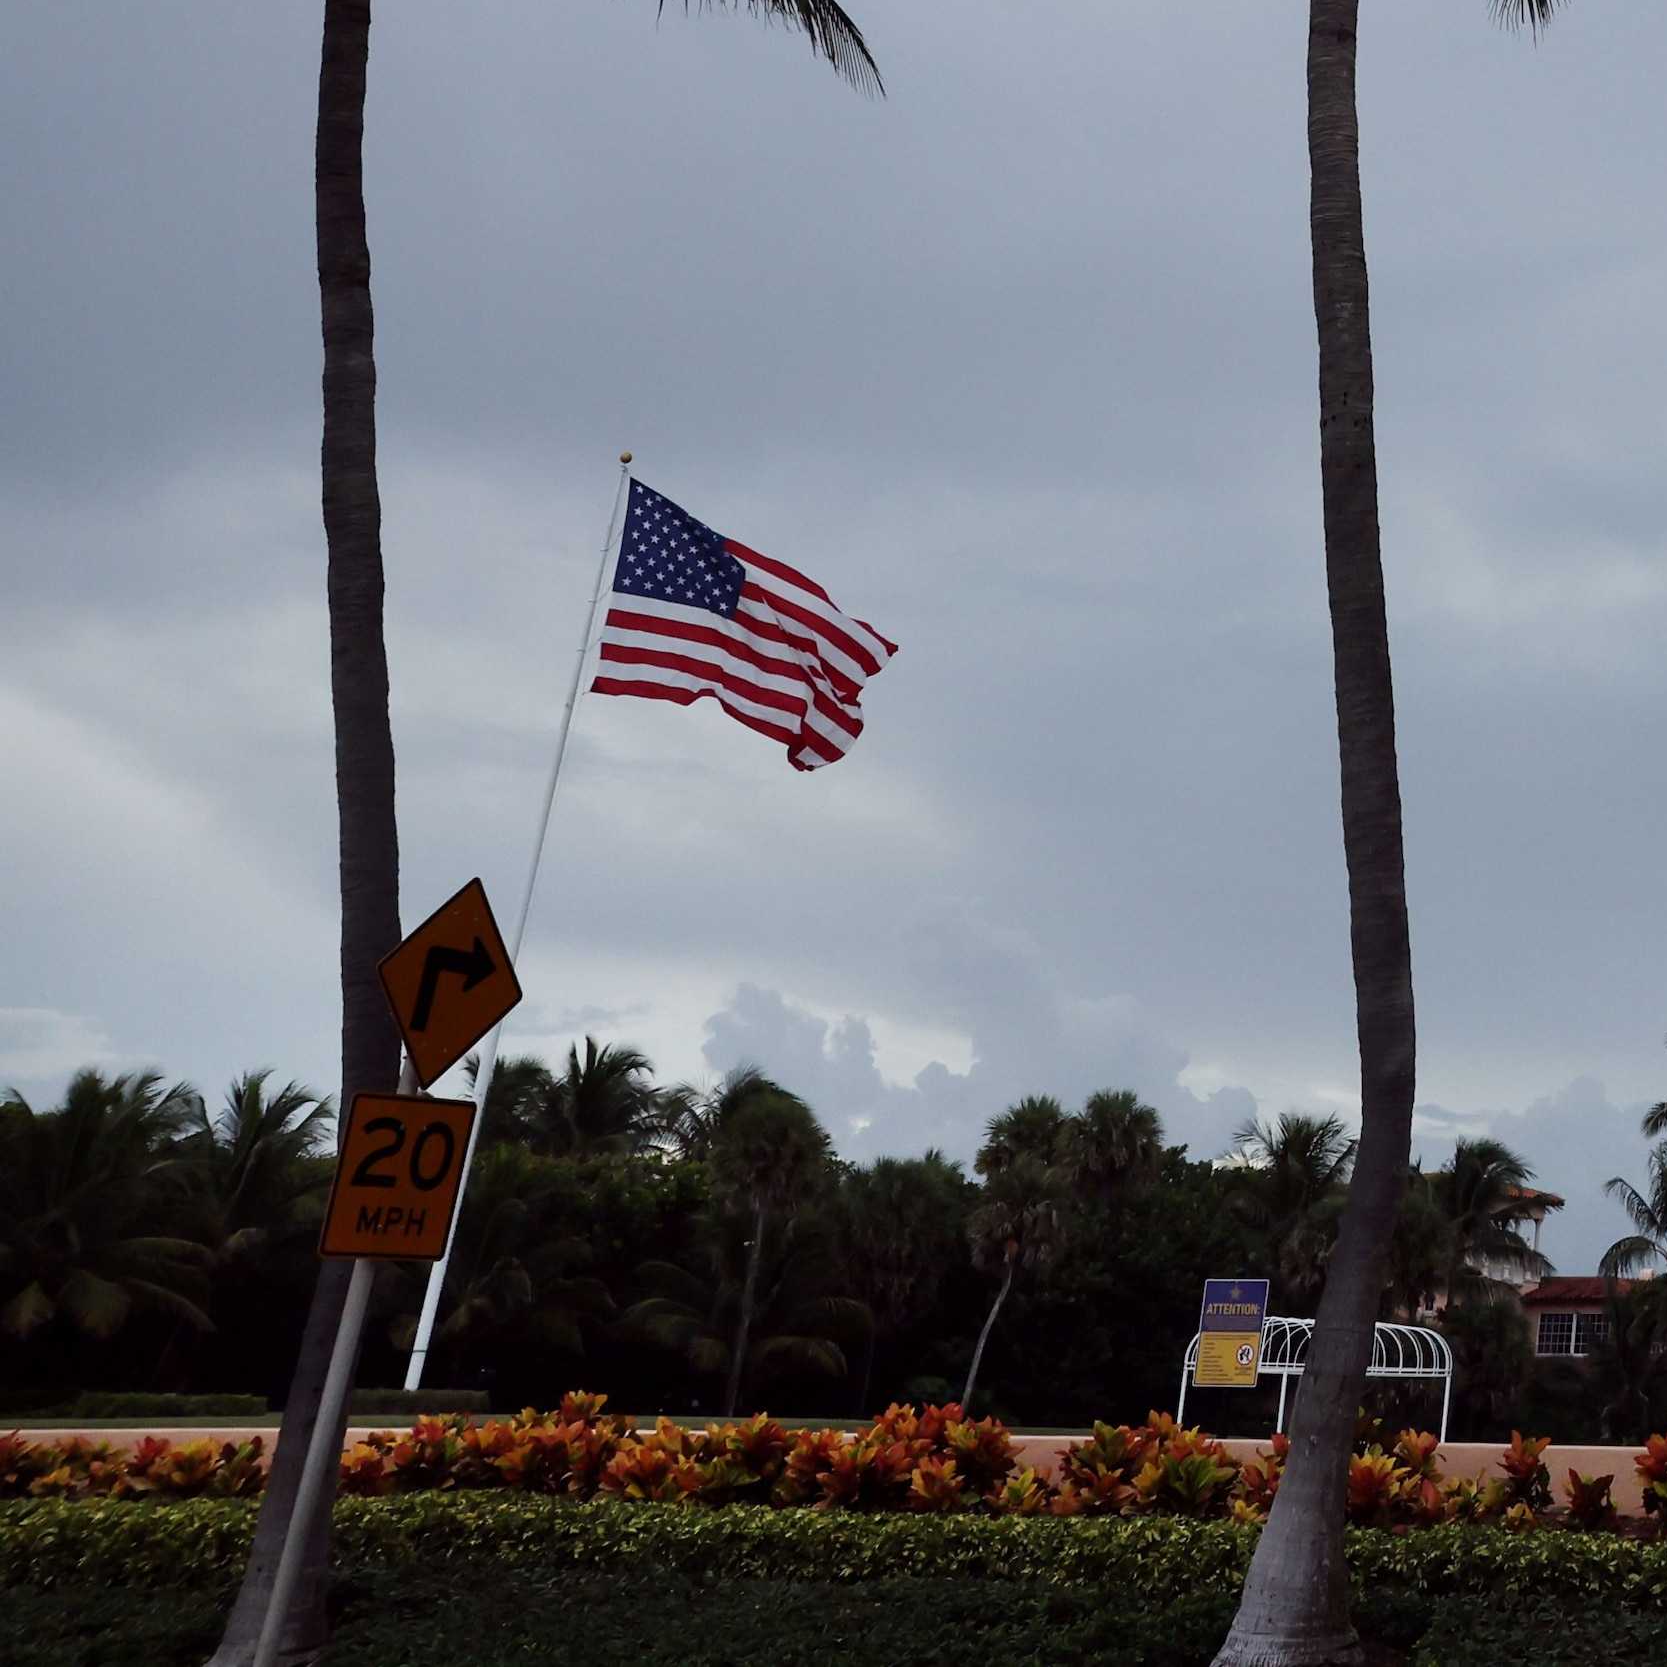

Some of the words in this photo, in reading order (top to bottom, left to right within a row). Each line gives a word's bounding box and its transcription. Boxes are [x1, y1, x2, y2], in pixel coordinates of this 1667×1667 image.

[351, 1117, 454, 1192] 20
[356, 1206, 427, 1238] MPH
[1205, 1303, 1261, 1316] ATTENTION:
